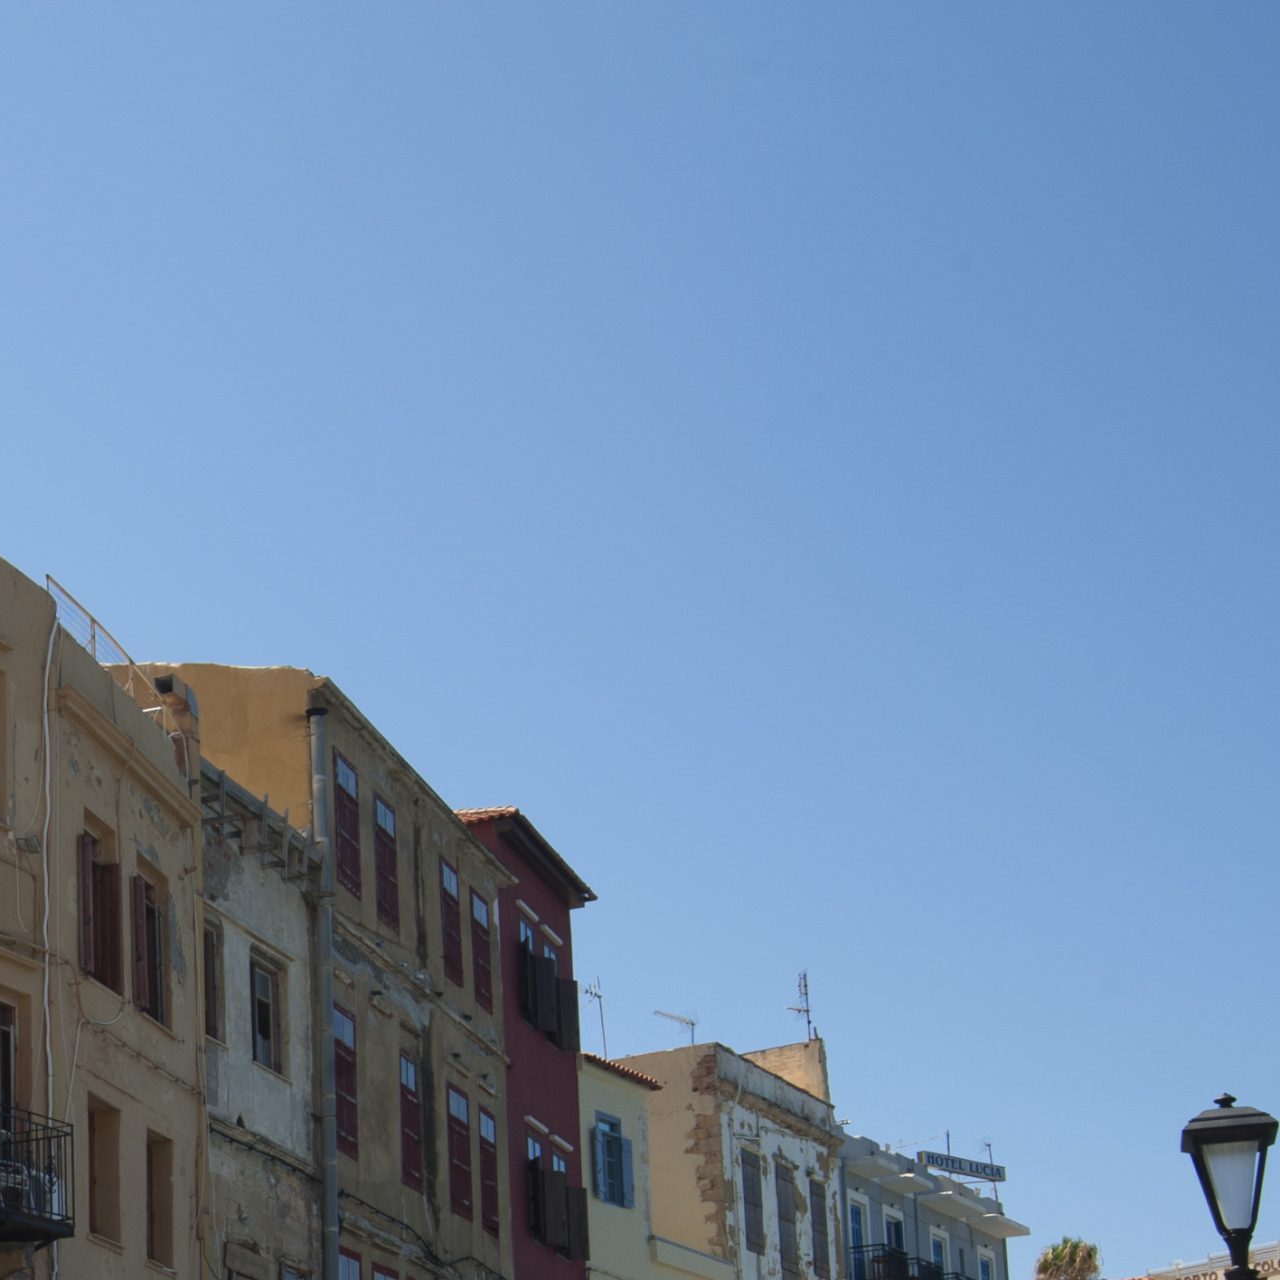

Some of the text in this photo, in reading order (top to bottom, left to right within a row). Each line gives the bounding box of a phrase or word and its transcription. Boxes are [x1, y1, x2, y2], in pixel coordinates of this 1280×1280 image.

[926, 1153, 1002, 1179] HOTEL LUCIA
[1253, 1258, 1280, 1273] COL
